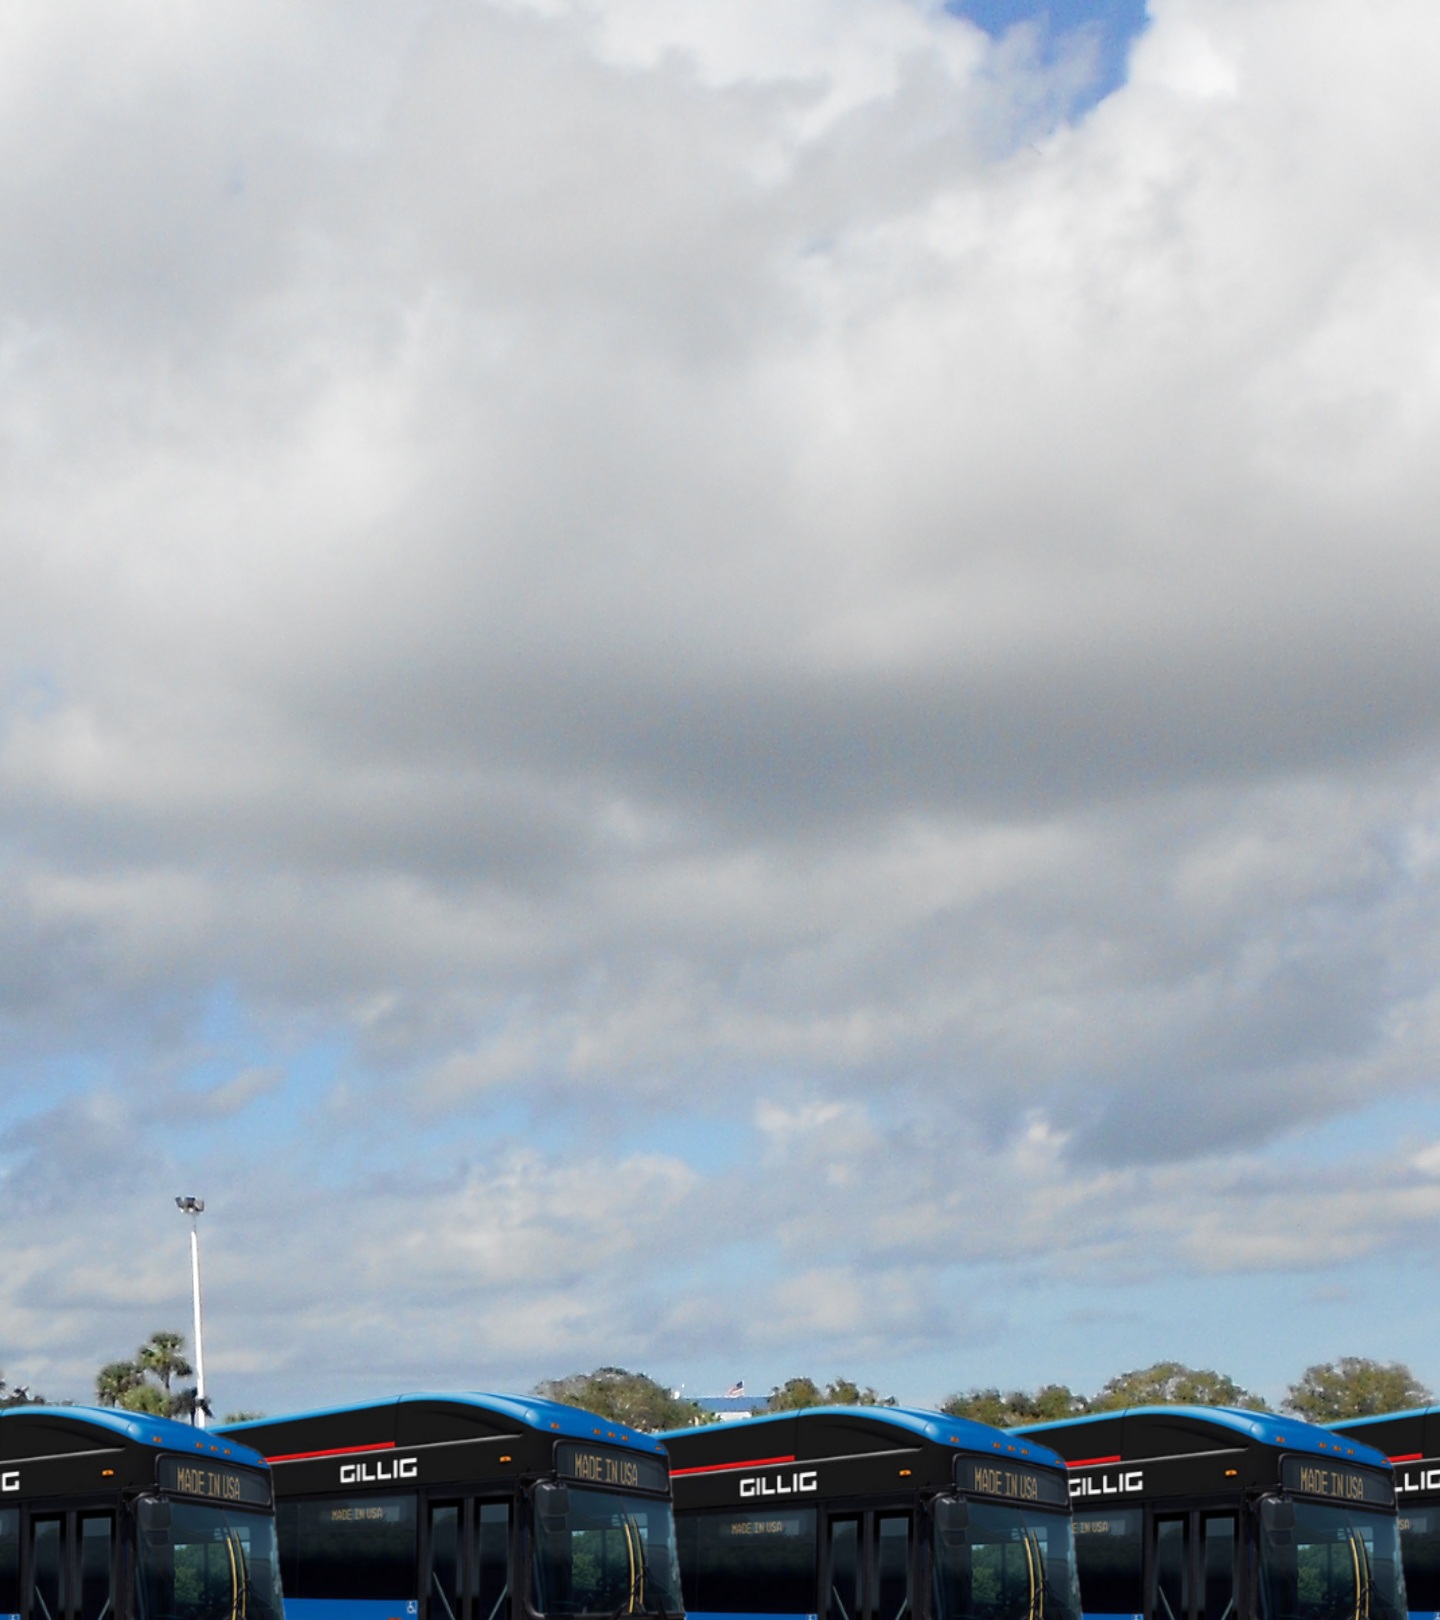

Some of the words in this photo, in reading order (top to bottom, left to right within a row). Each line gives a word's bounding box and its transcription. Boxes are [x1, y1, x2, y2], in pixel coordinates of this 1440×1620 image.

[177, 1469, 205, 1493] MADE
[208, 1471, 221, 1497] IN
[223, 1476, 241, 1499] USA
[339, 1457, 418, 1484] GILLIG
[575, 1455, 603, 1480] MADE
[605, 1458, 619, 1483] IN
[622, 1462, 637, 1485] USA
[739, 1471, 817, 1497] GILLIG
[974, 1469, 1002, 1494] MADE
[1005, 1471, 1018, 1497] IN
[1020, 1476, 1037, 1499] USA
[1068, 1471, 1143, 1497] GILLIG
[1300, 1469, 1328, 1494] MADE
[1331, 1471, 1344, 1497] IN
[1345, 1476, 1363, 1500] USA
